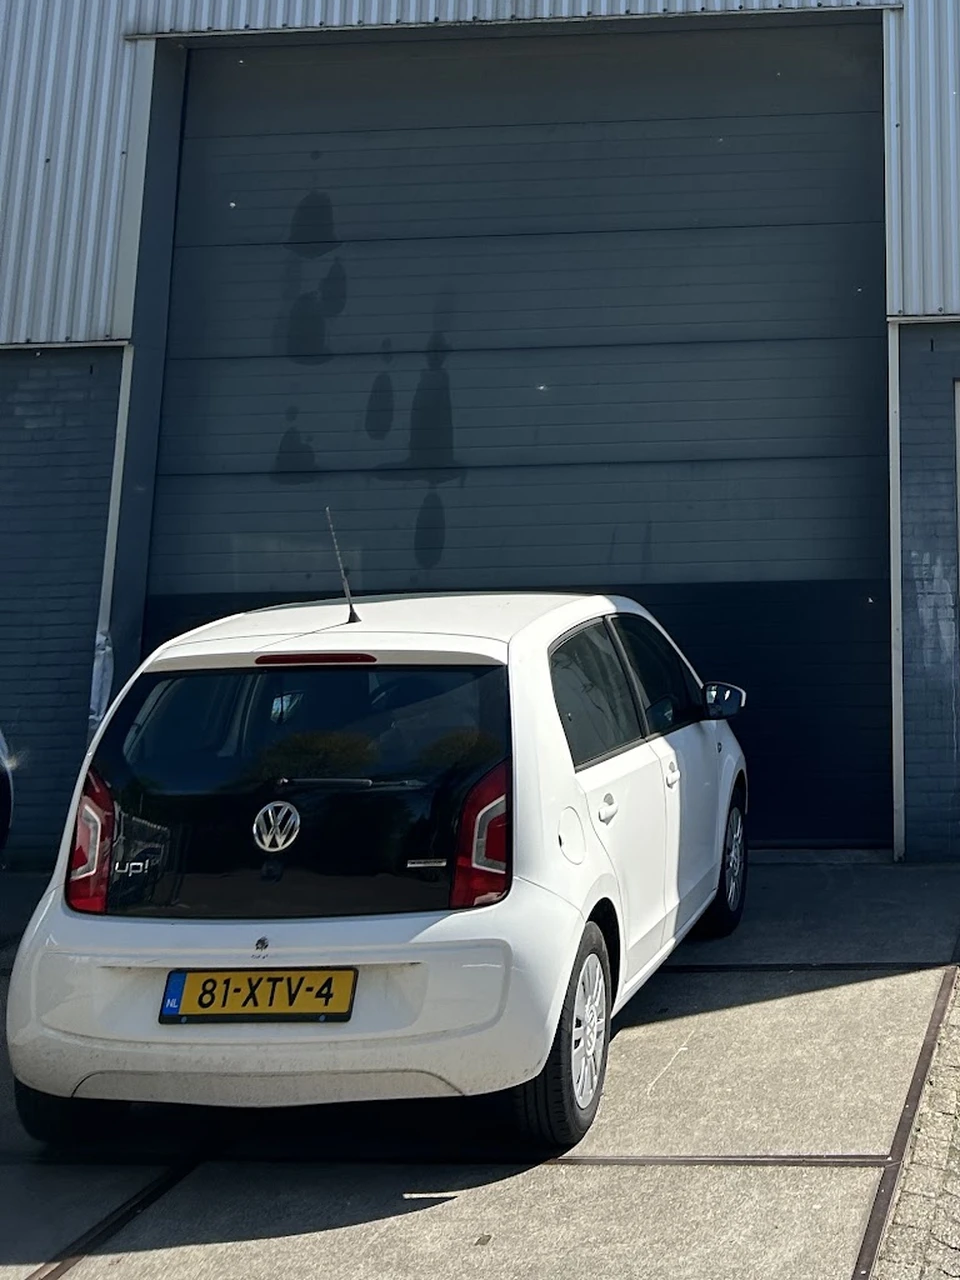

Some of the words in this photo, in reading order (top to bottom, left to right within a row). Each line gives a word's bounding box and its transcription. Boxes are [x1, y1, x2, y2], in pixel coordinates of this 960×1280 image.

[114, 857, 150, 878] up!
[165, 998, 179, 1008] NL
[197, 976, 334, 1009] 81-XTV-4
